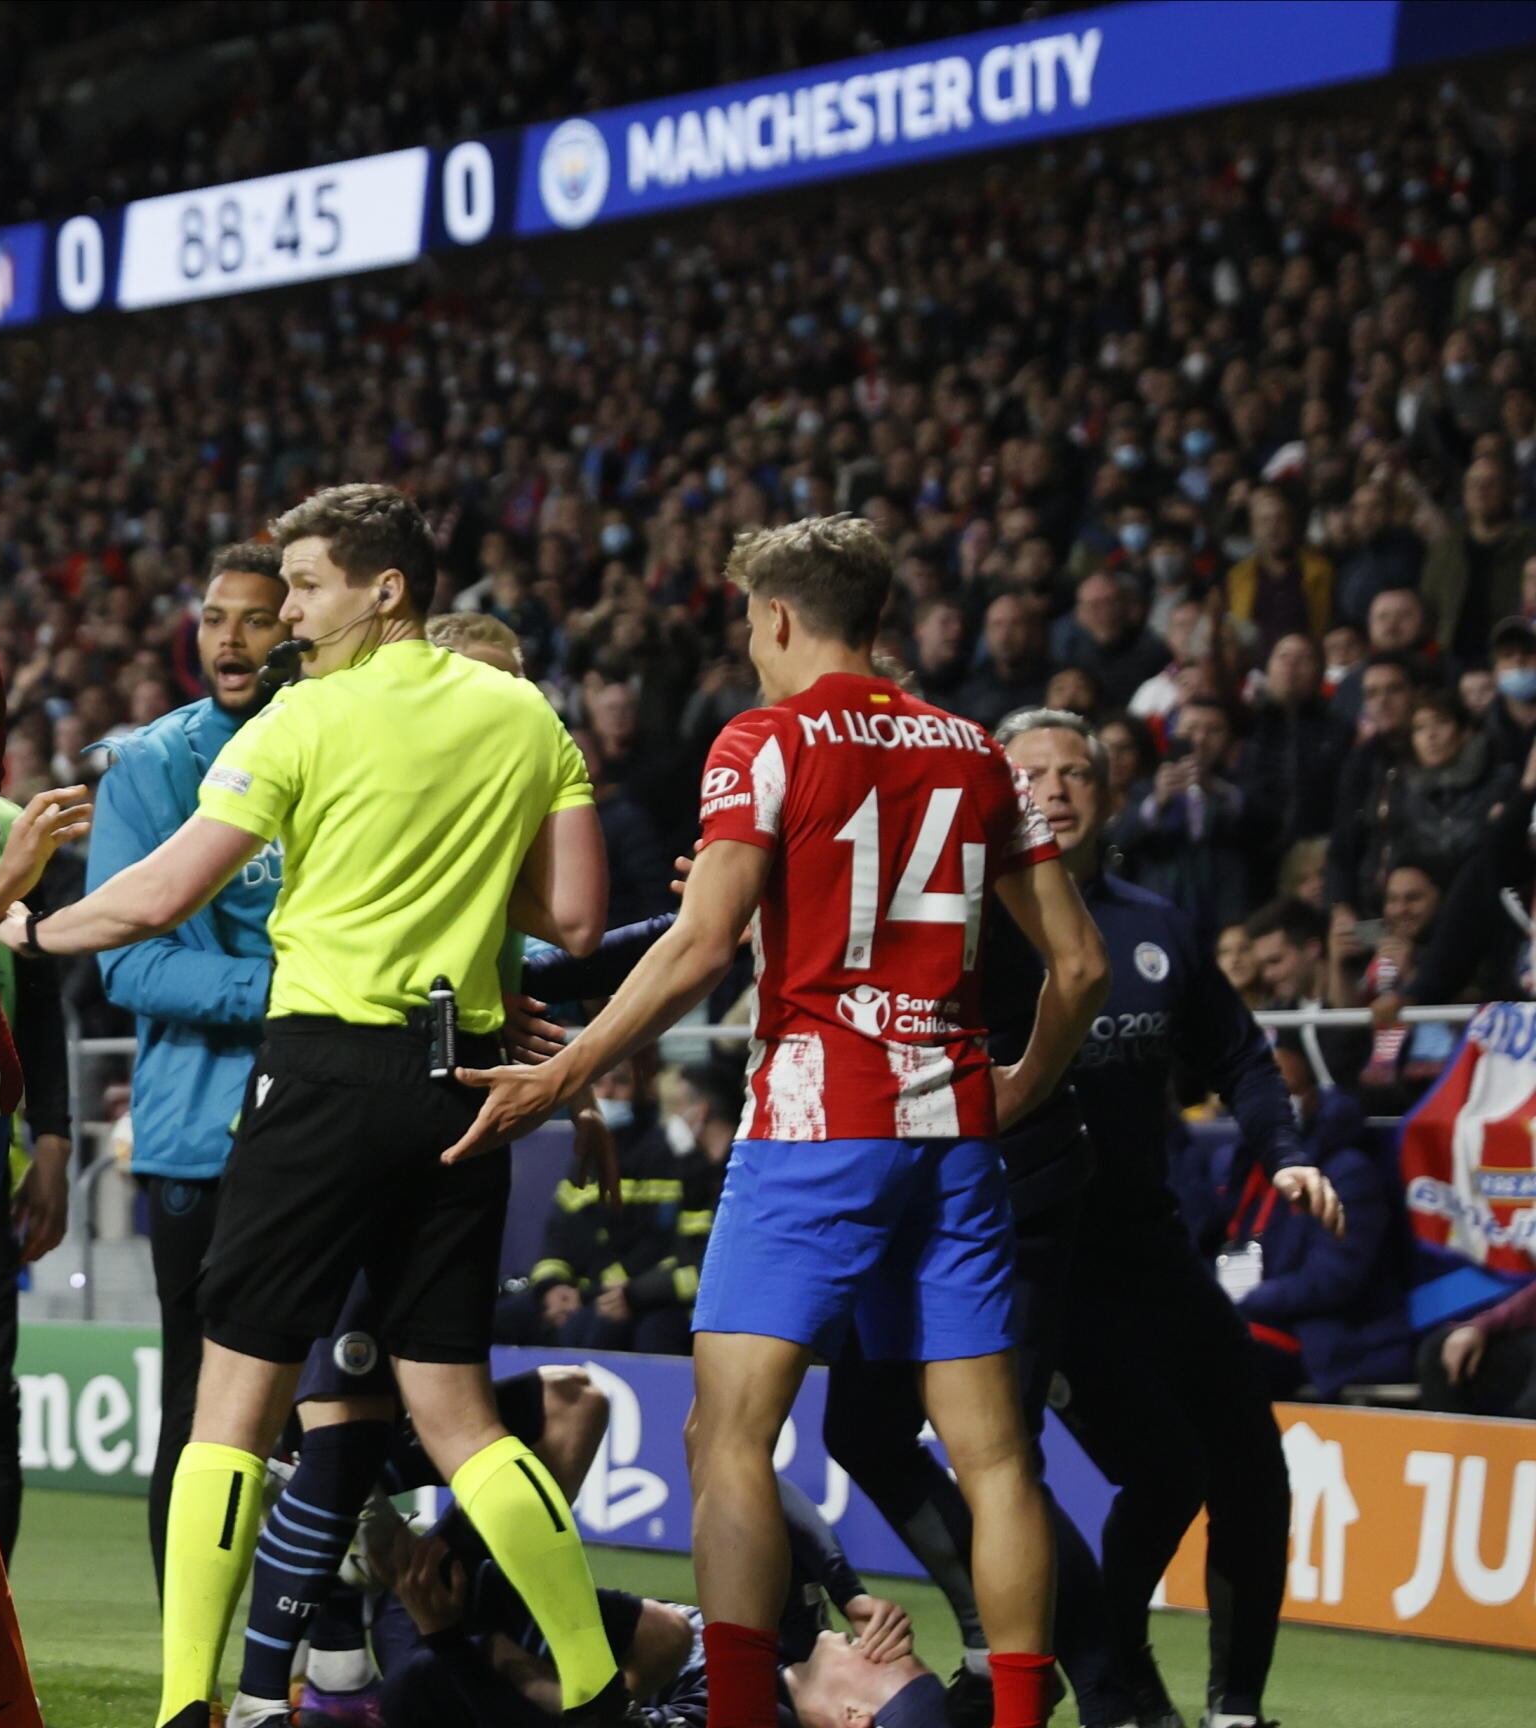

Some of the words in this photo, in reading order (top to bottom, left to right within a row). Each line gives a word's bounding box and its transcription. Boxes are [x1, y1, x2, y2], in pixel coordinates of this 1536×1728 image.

[627, 56, 974, 195] MANCHESTER
[977, 27, 1102, 124] CITY
[179, 178, 343, 280] 88:45
[442, 140, 495, 246] 0
[56, 215, 105, 313] 0
[798, 709, 843, 746] M.
[842, 709, 991, 755] LLORENTE
[835, 785, 986, 971] 14
[1392, 1450, 1536, 1620] JU
